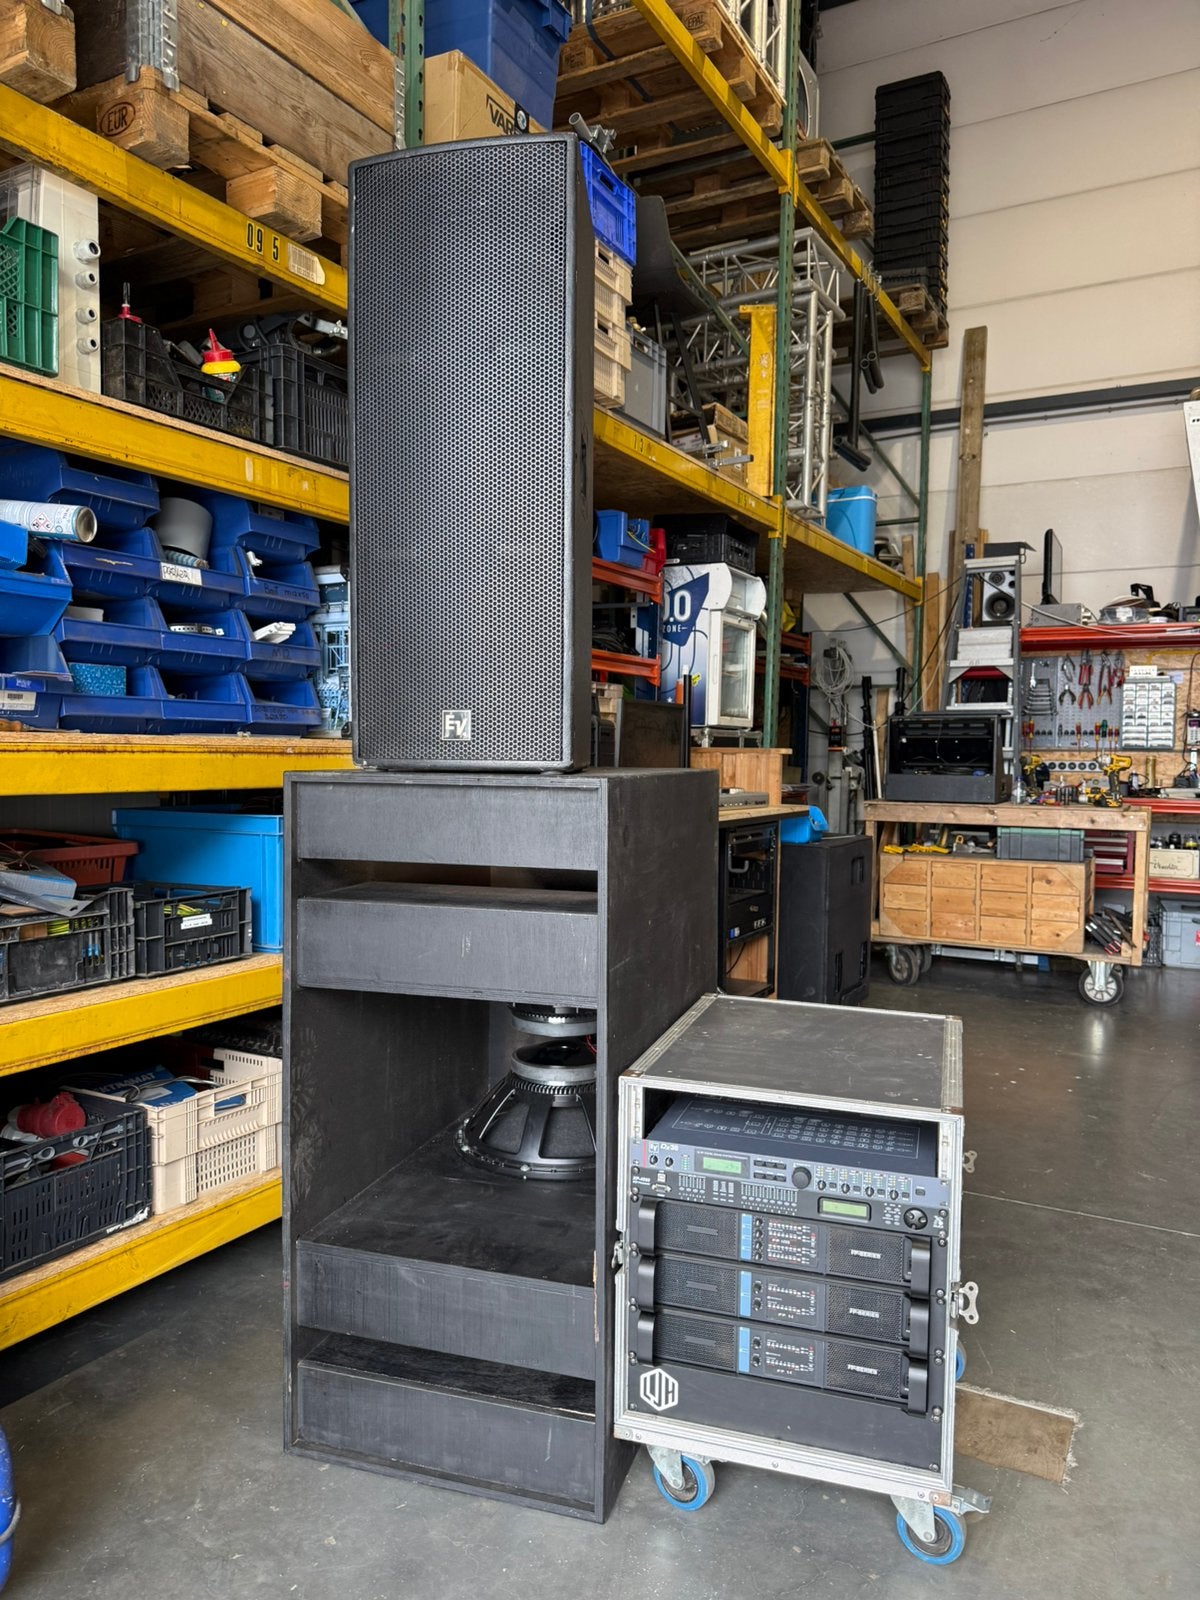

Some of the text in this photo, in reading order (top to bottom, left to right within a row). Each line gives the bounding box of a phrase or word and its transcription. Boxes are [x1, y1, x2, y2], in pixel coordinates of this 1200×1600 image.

[107, 106, 128, 132] EUR
[247, 222, 279, 261] 09 5
